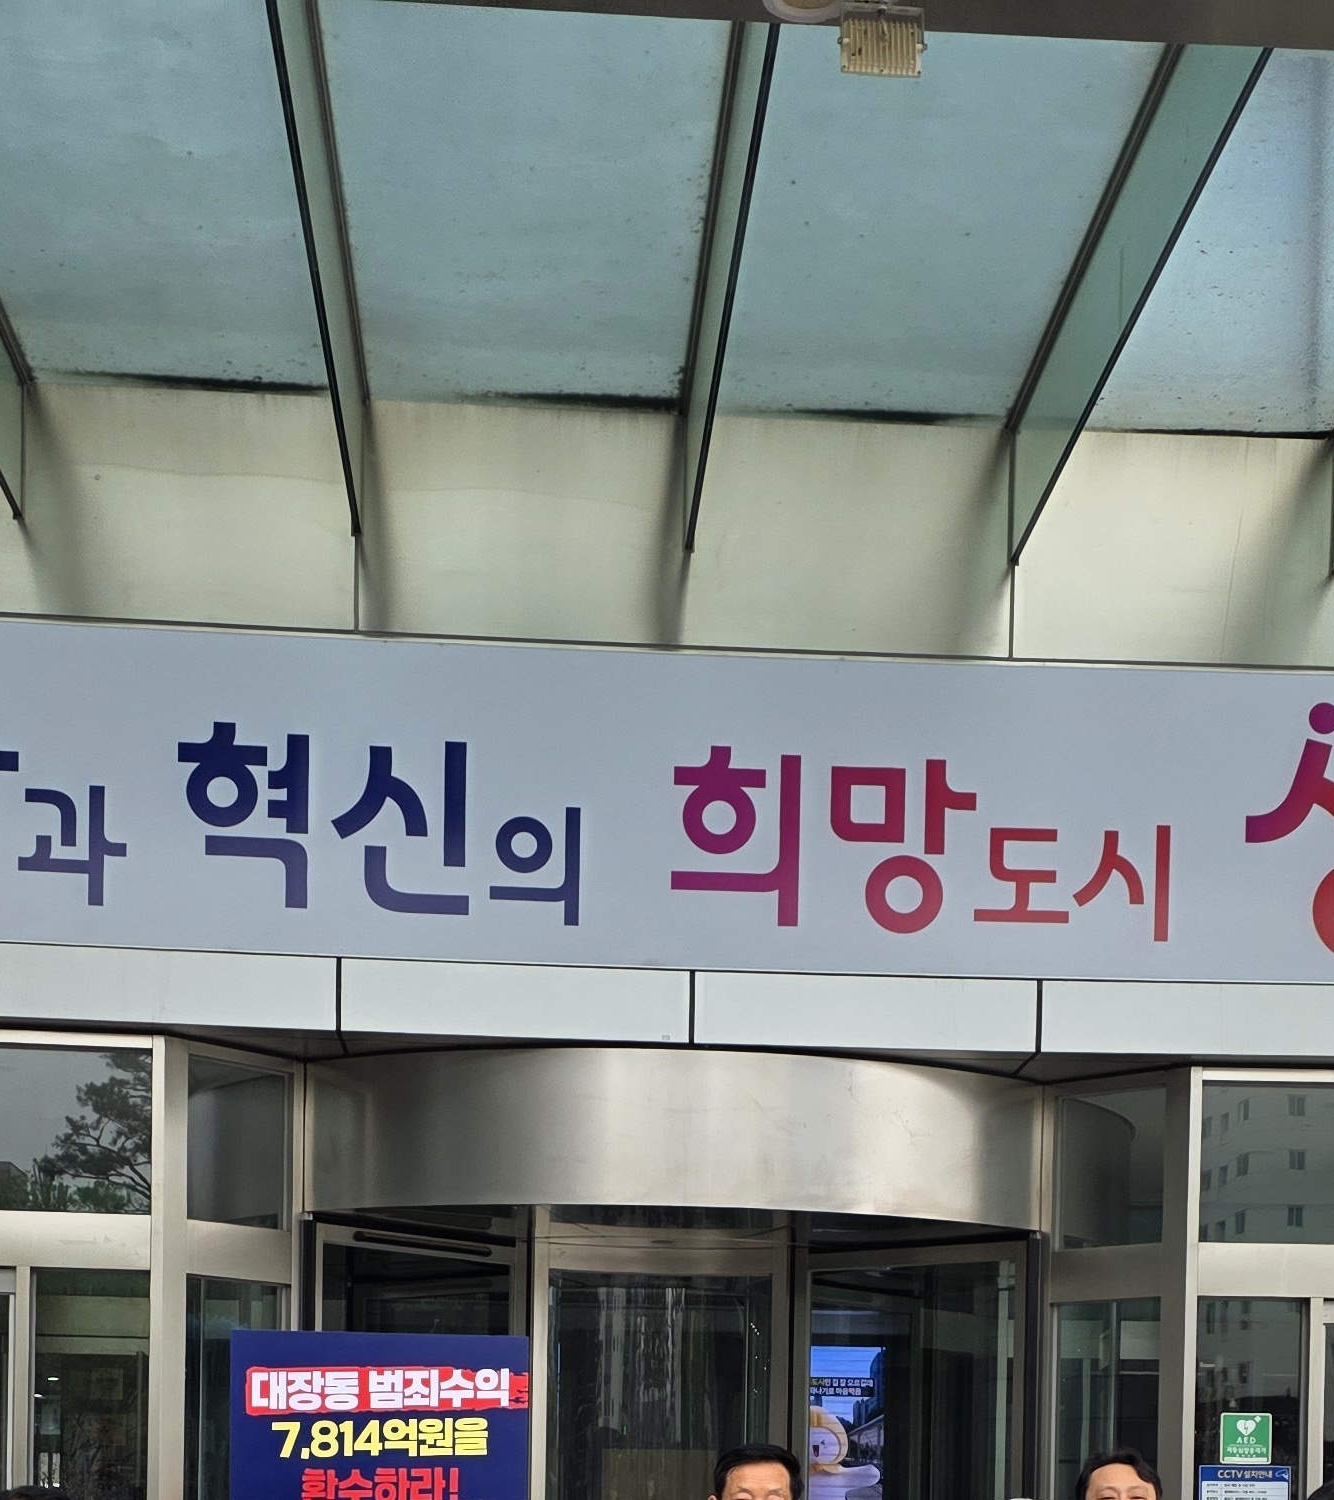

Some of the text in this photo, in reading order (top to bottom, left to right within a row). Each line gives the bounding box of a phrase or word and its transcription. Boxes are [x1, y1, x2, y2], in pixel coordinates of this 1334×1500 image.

[176, 721, 581, 927] 혁신의
[670, 745, 1172, 943] 희망도시
[250, 1367, 511, 1411] 대장동 범죄수익
[271, 1417, 489, 1460] 7,814억원을
[1236, 1436, 1257, 1444] AED
